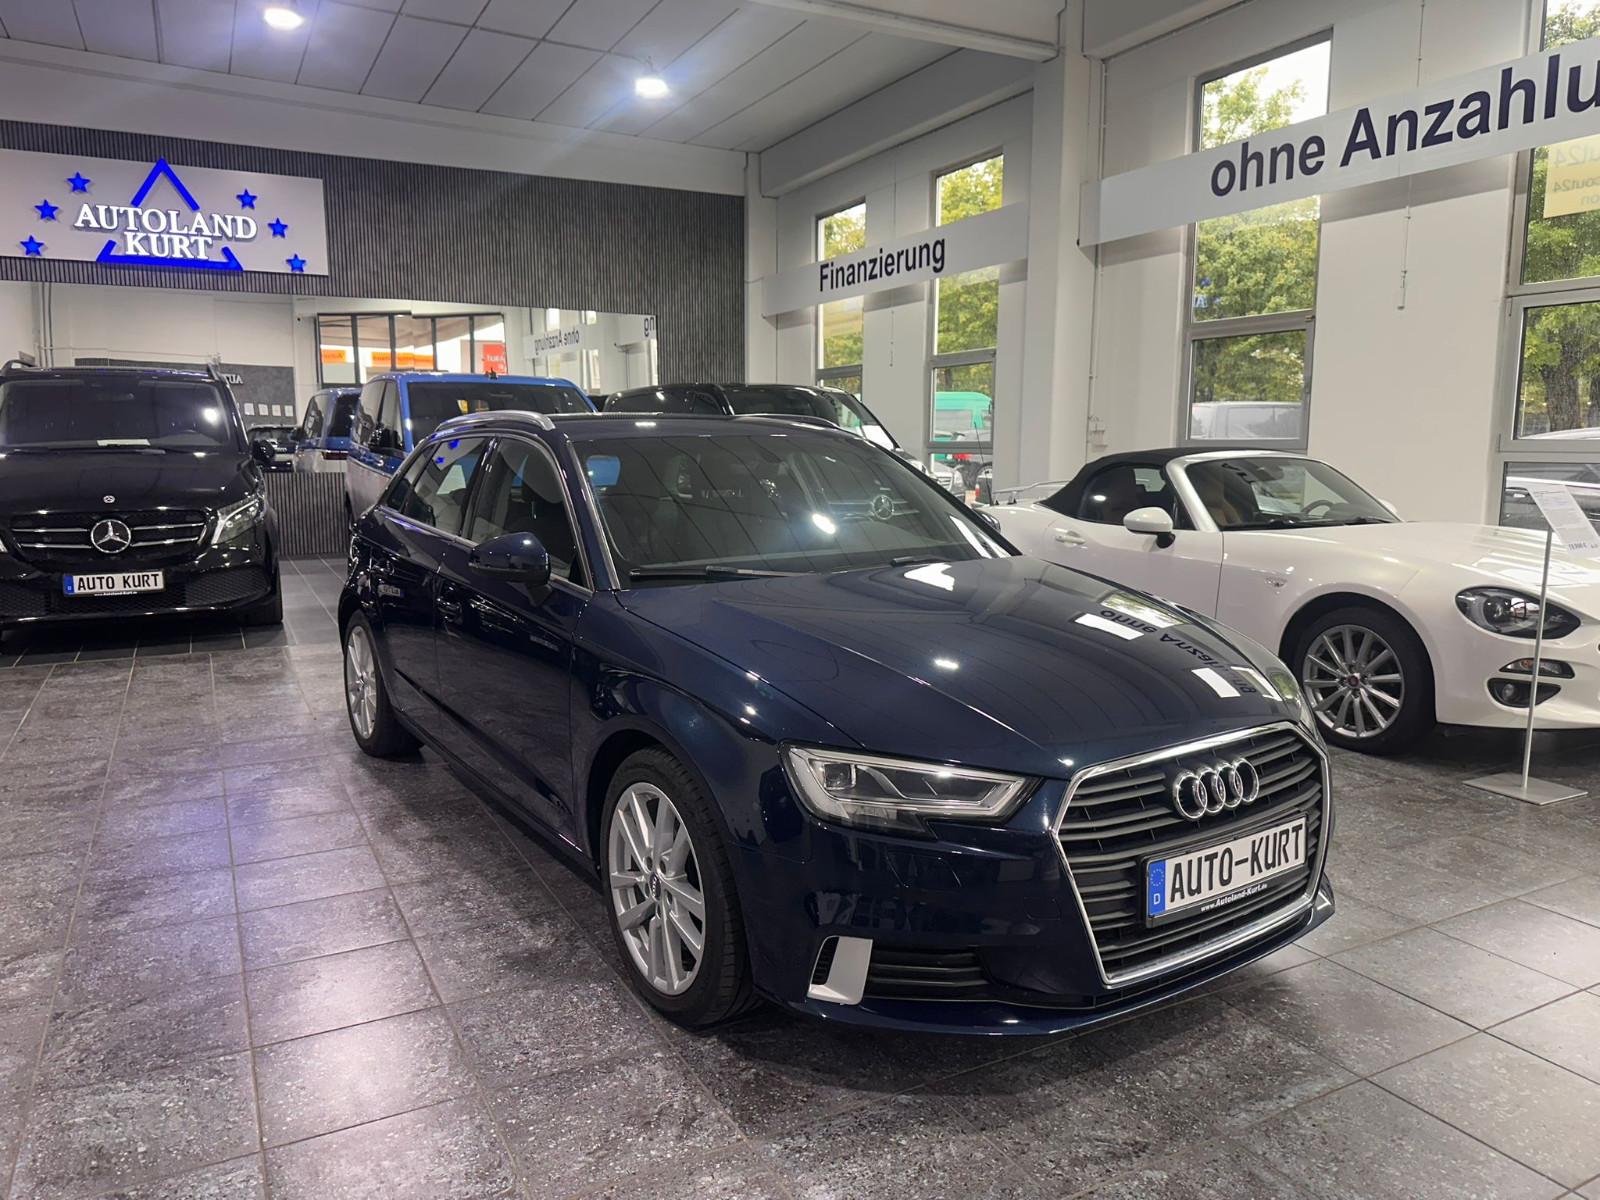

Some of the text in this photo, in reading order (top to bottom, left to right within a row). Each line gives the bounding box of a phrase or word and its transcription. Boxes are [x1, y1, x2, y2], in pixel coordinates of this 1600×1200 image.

[1211, 54, 1600, 197] ohne Anzahlu
[74, 203, 257, 239] AUTOLAND
[124, 231, 212, 260] KURT
[819, 238, 945, 292] Finanzierung
[78, 574, 159, 591] AUTO KURT
[1170, 825, 1303, 903] AUTO-KURT
[1153, 893, 1160, 905] D
